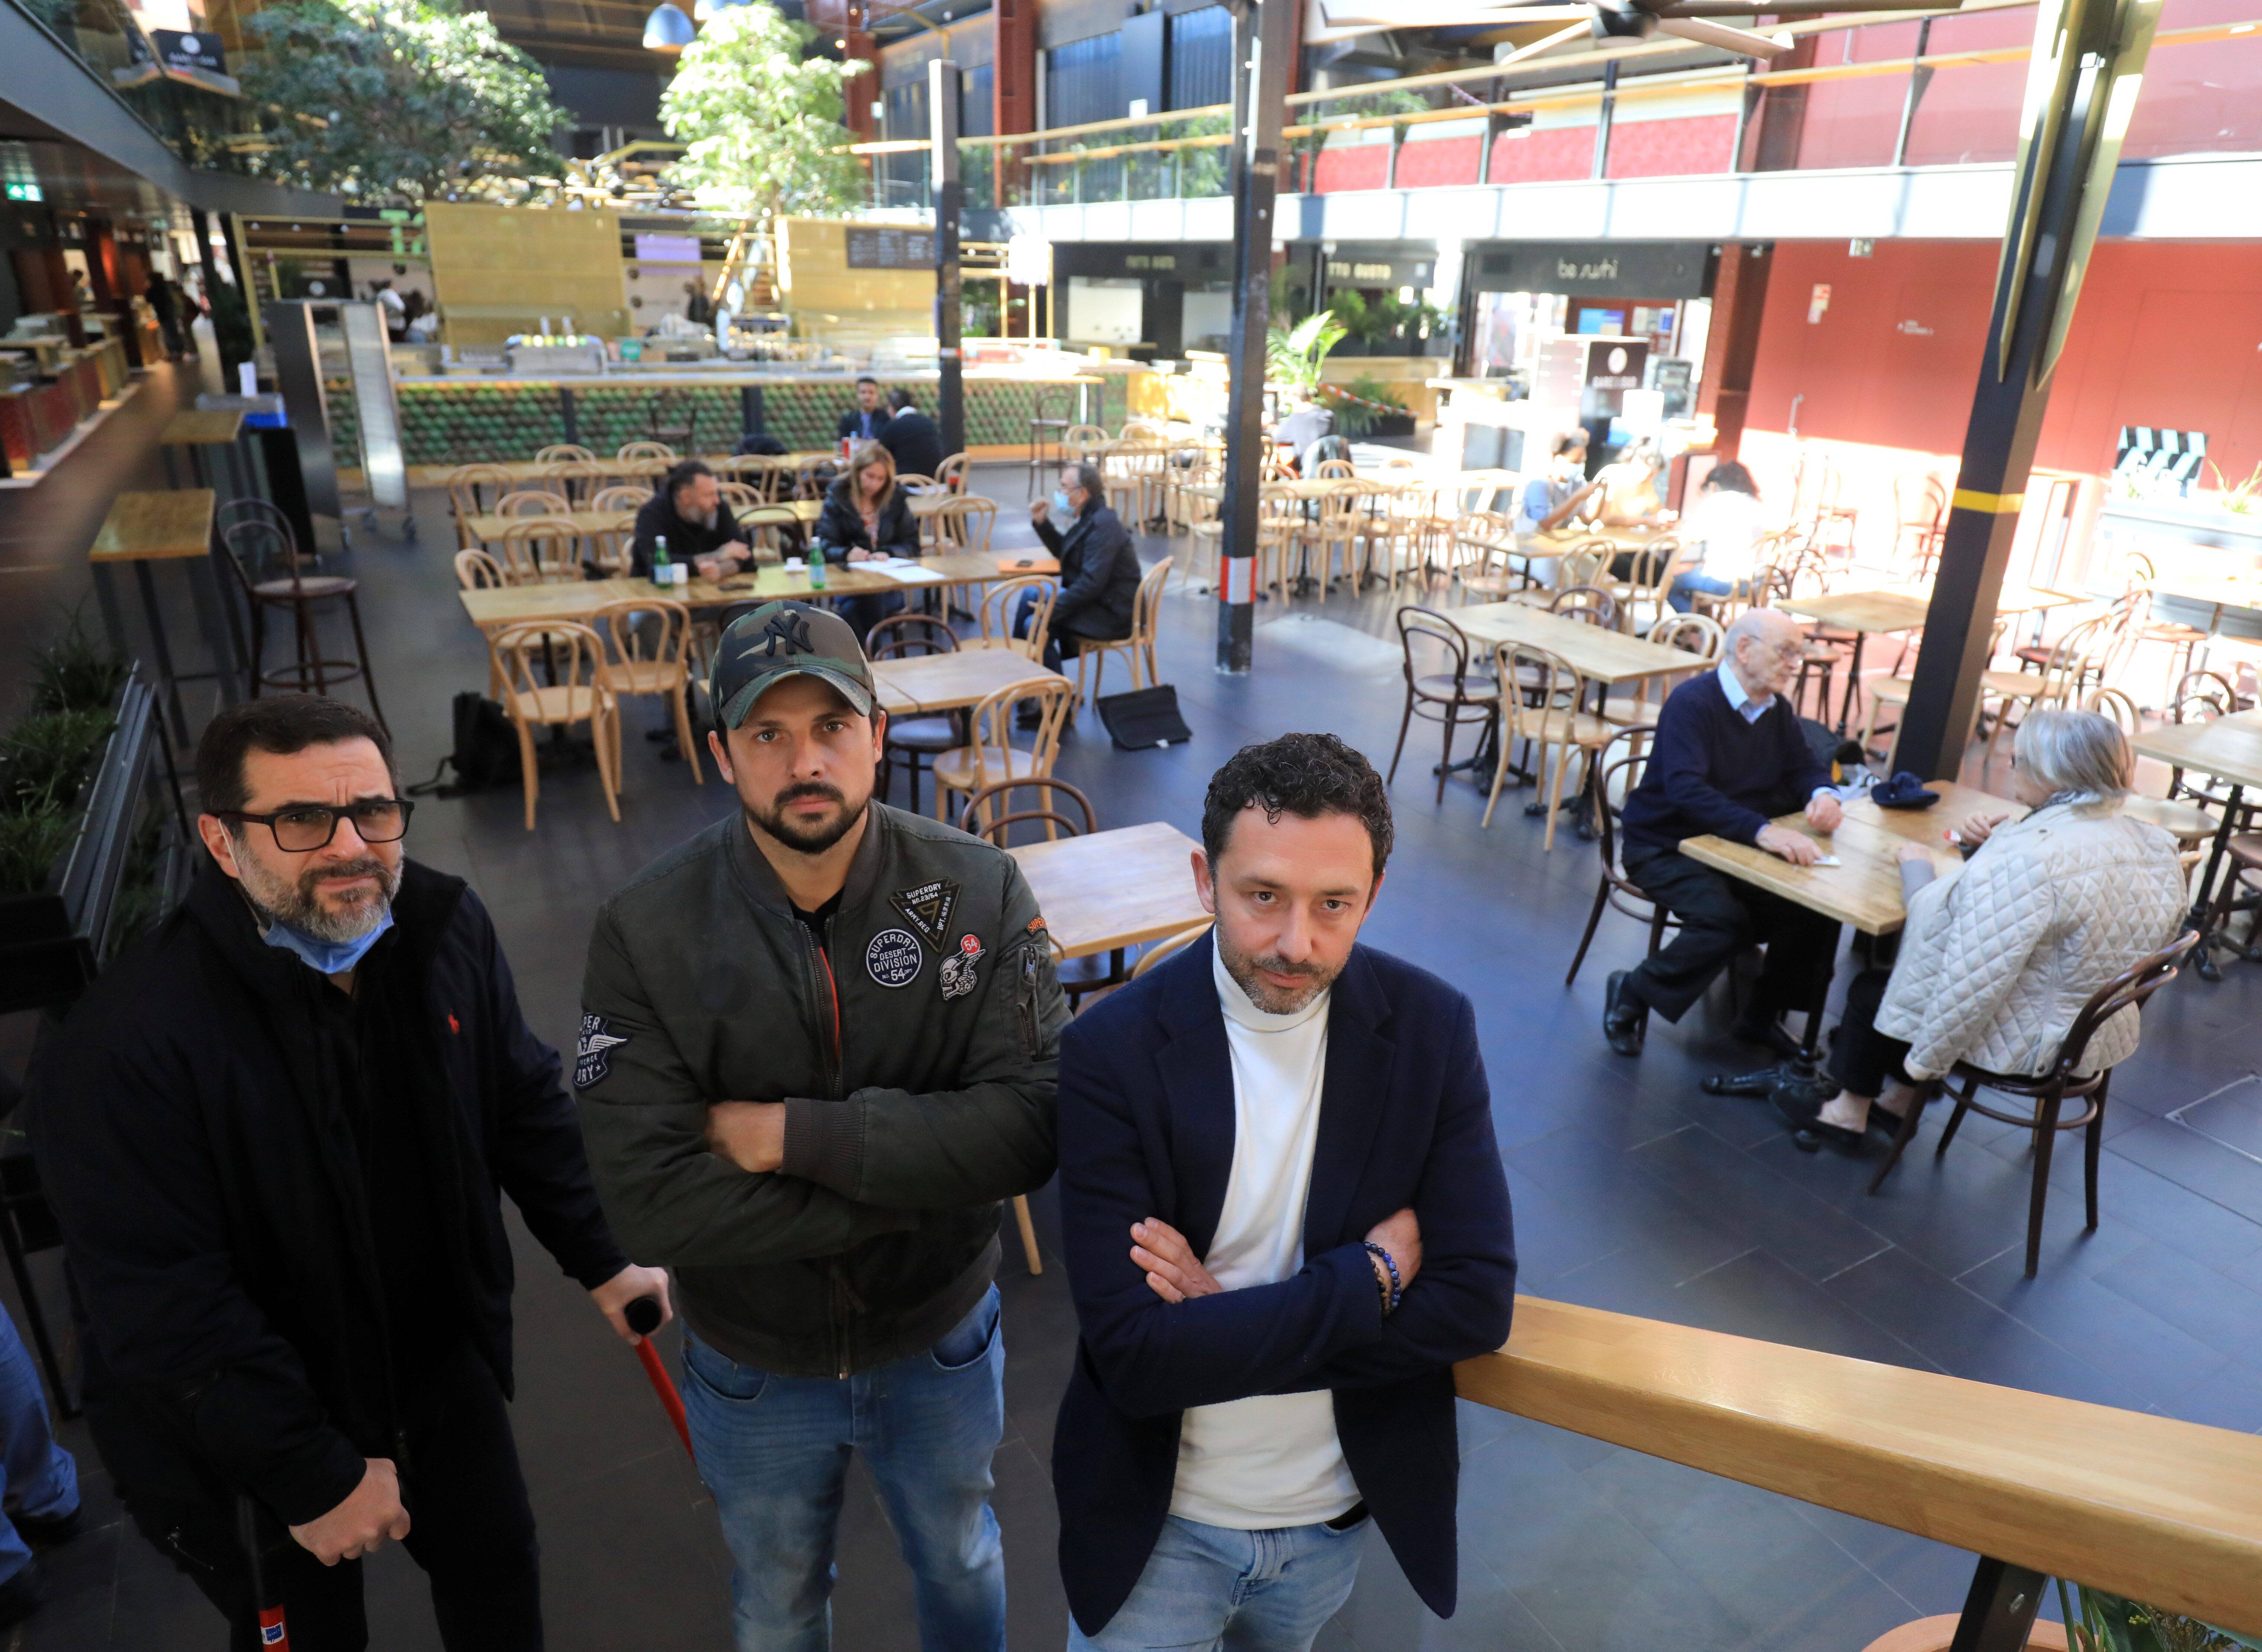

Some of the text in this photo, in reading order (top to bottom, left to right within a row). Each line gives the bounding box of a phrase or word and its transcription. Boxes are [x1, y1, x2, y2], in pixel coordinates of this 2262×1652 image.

[764, 612, 814, 656] NY
[906, 883, 941, 899] SUPERDRY
[870, 934, 916, 959] SUPERDRY
[964, 938, 978, 951] 54
[879, 948, 906, 961] DESERT
[874, 954, 917, 973] DIVISION
[890, 968, 905, 981] 54
